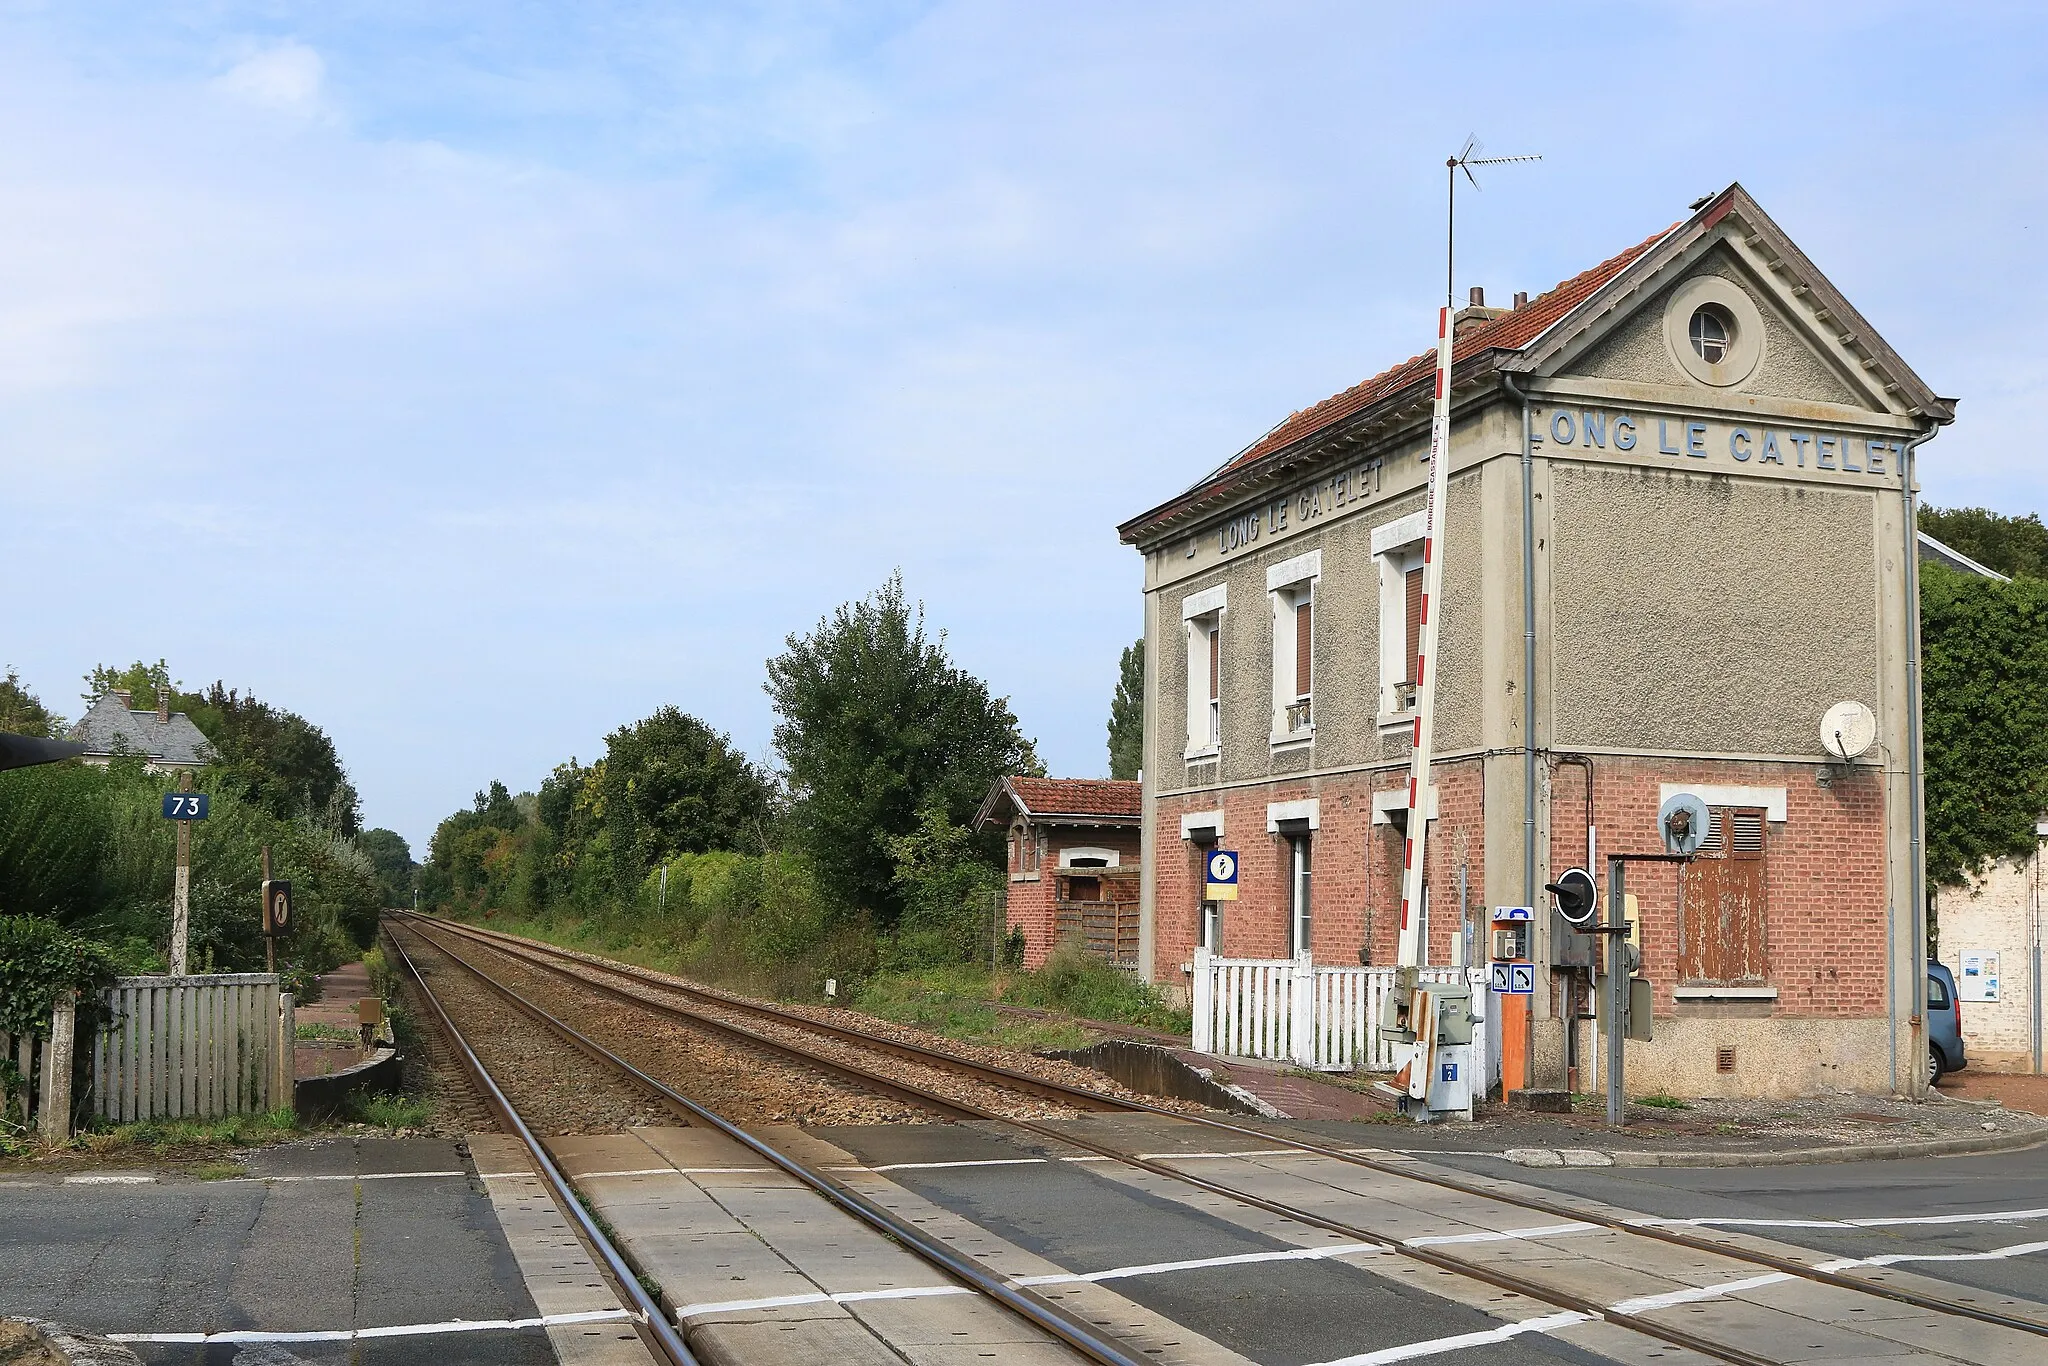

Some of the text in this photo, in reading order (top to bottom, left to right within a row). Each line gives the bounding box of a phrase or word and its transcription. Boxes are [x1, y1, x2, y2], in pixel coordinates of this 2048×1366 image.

[1529, 409, 1905, 476] ONG LE CATELET
[1219, 458, 1382, 554] LONG LE CATELET
[172, 796, 200, 816] 73
[1447, 1071, 1452, 1081] 2
